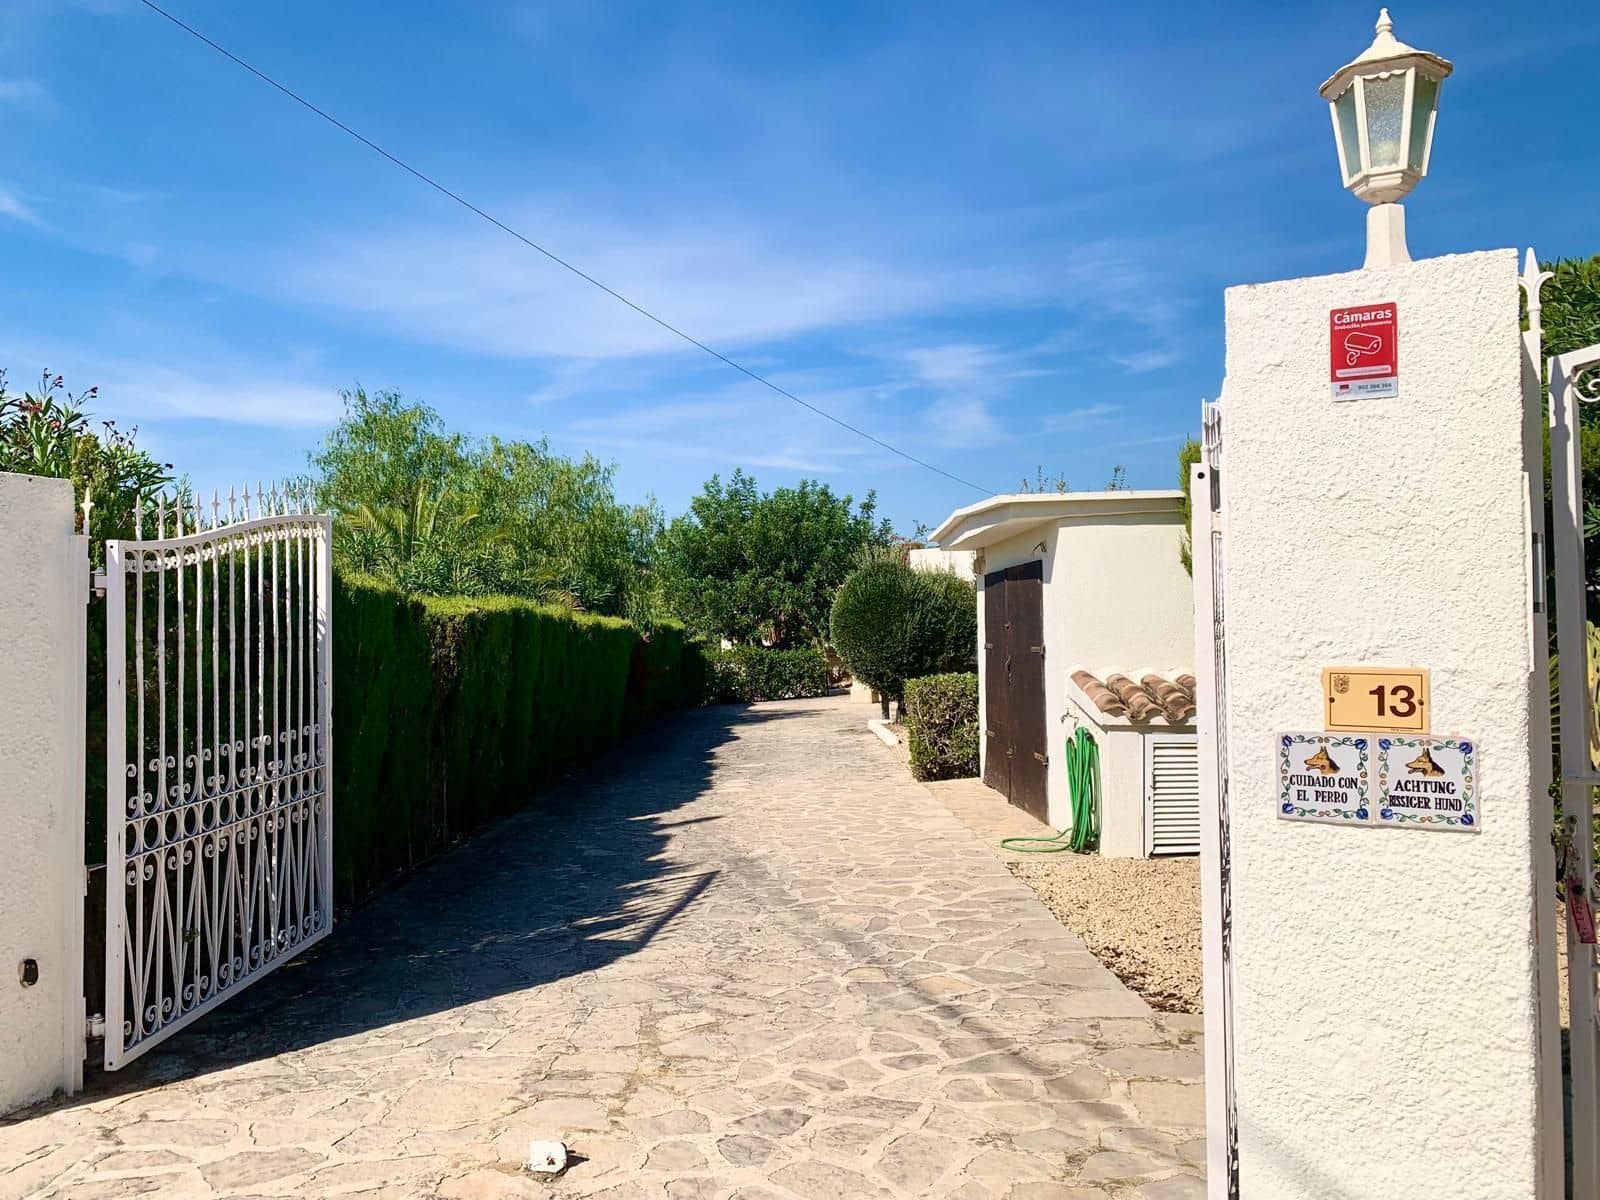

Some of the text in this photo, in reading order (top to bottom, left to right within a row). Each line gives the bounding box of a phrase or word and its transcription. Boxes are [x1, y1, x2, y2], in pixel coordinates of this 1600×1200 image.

[1334, 309, 1392, 324] Cámaras
[1369, 685, 1417, 718] 13
[1289, 774, 1359, 790] CUIDADO CON
[1394, 779, 1457, 795] ACHTUNG
[1296, 789, 1349, 804] EL PERRO
[1434, 797, 1463, 812] HUND
